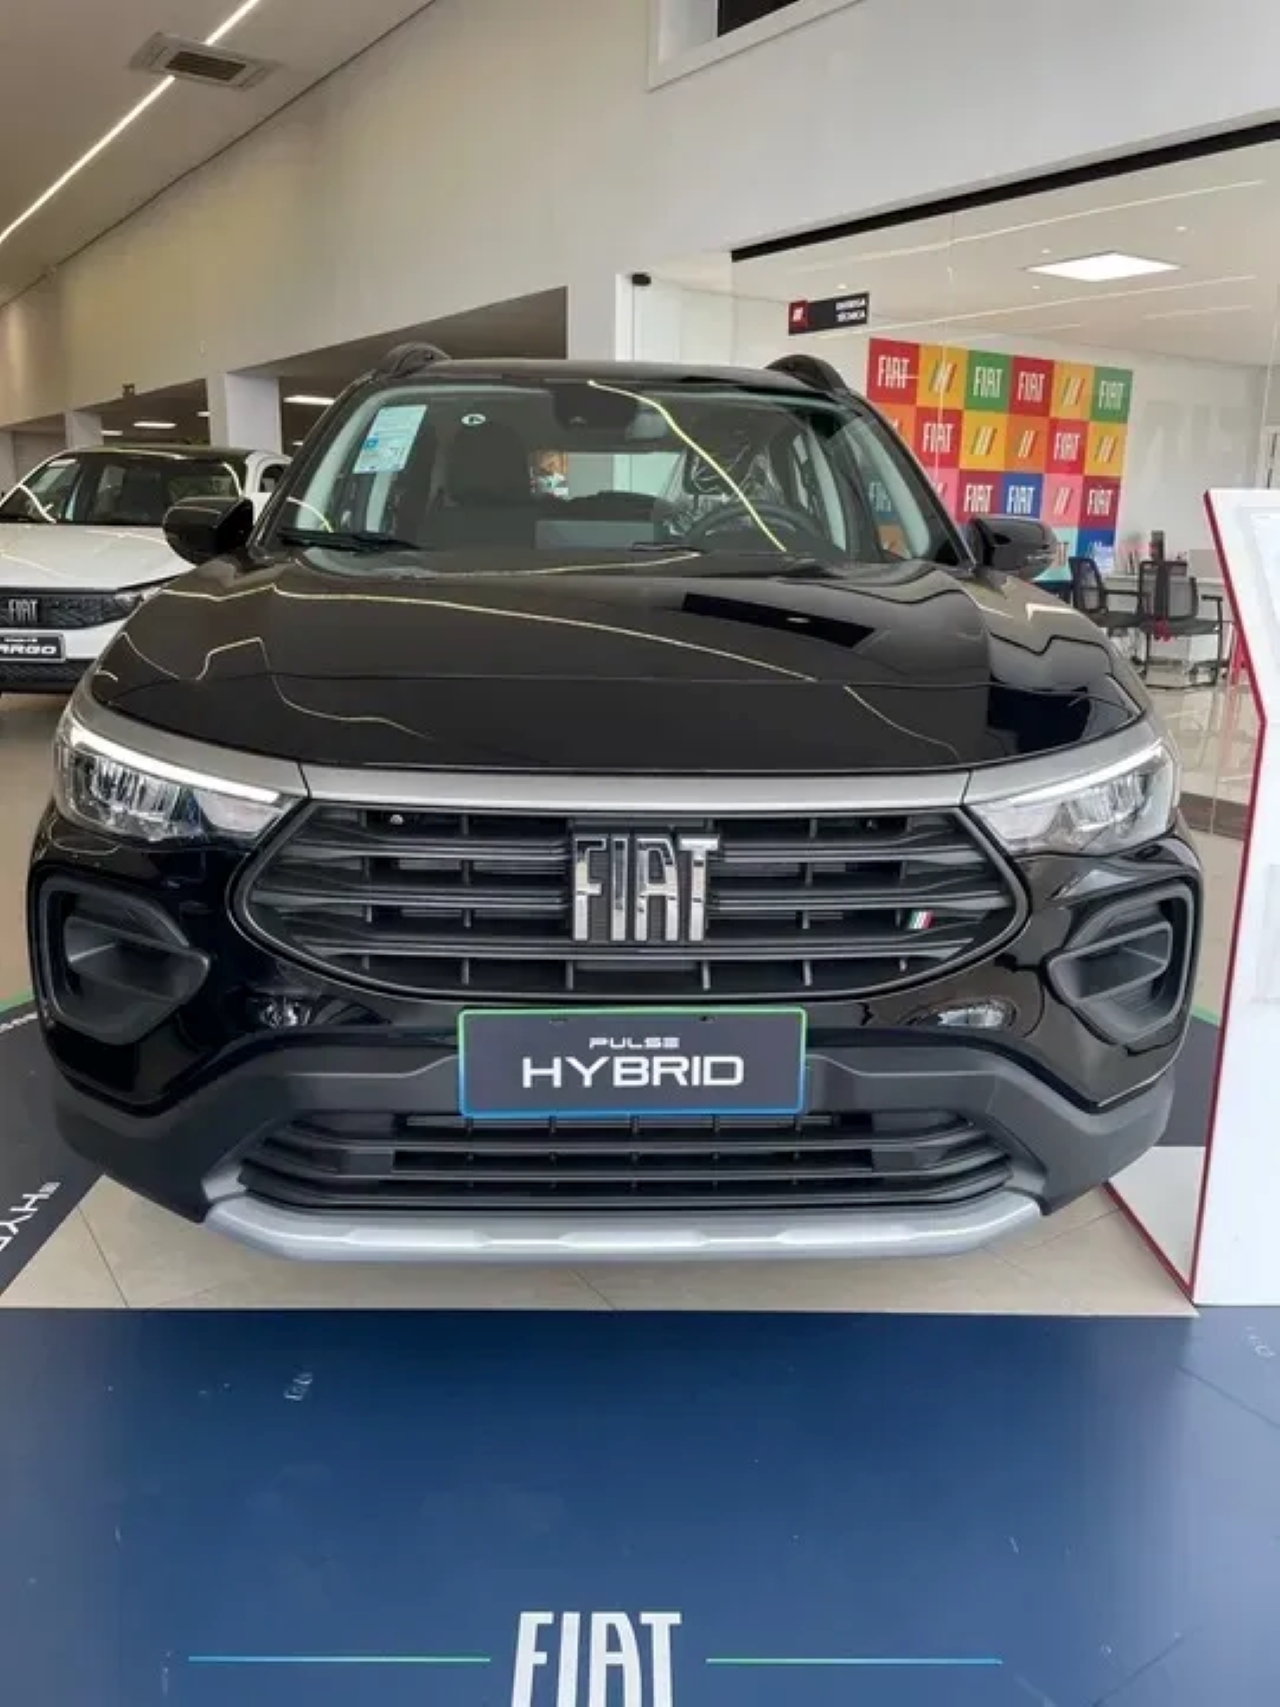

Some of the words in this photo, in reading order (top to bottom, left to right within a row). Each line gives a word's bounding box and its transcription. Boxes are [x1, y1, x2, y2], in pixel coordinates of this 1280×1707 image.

[878, 355, 910, 389] FIAT
[973, 366, 1003, 398] FIAT
[1018, 371, 1045, 403] FIAT
[1099, 380, 1125, 410] FIAT
[923, 422, 955, 453] FIAT
[1054, 432, 1080, 462] FIAT
[964, 484, 994, 513] FIAT
[1006, 485, 1035, 515] FIAT
[1087, 488, 1113, 516] FIAT
[8, 598, 38, 621] FIAT
[572, 834, 720, 942] FIAT
[589, 1037, 681, 1049] PULSE
[522, 1055, 745, 1089] HYBRID
[511, 1611, 682, 1707] FIAT
